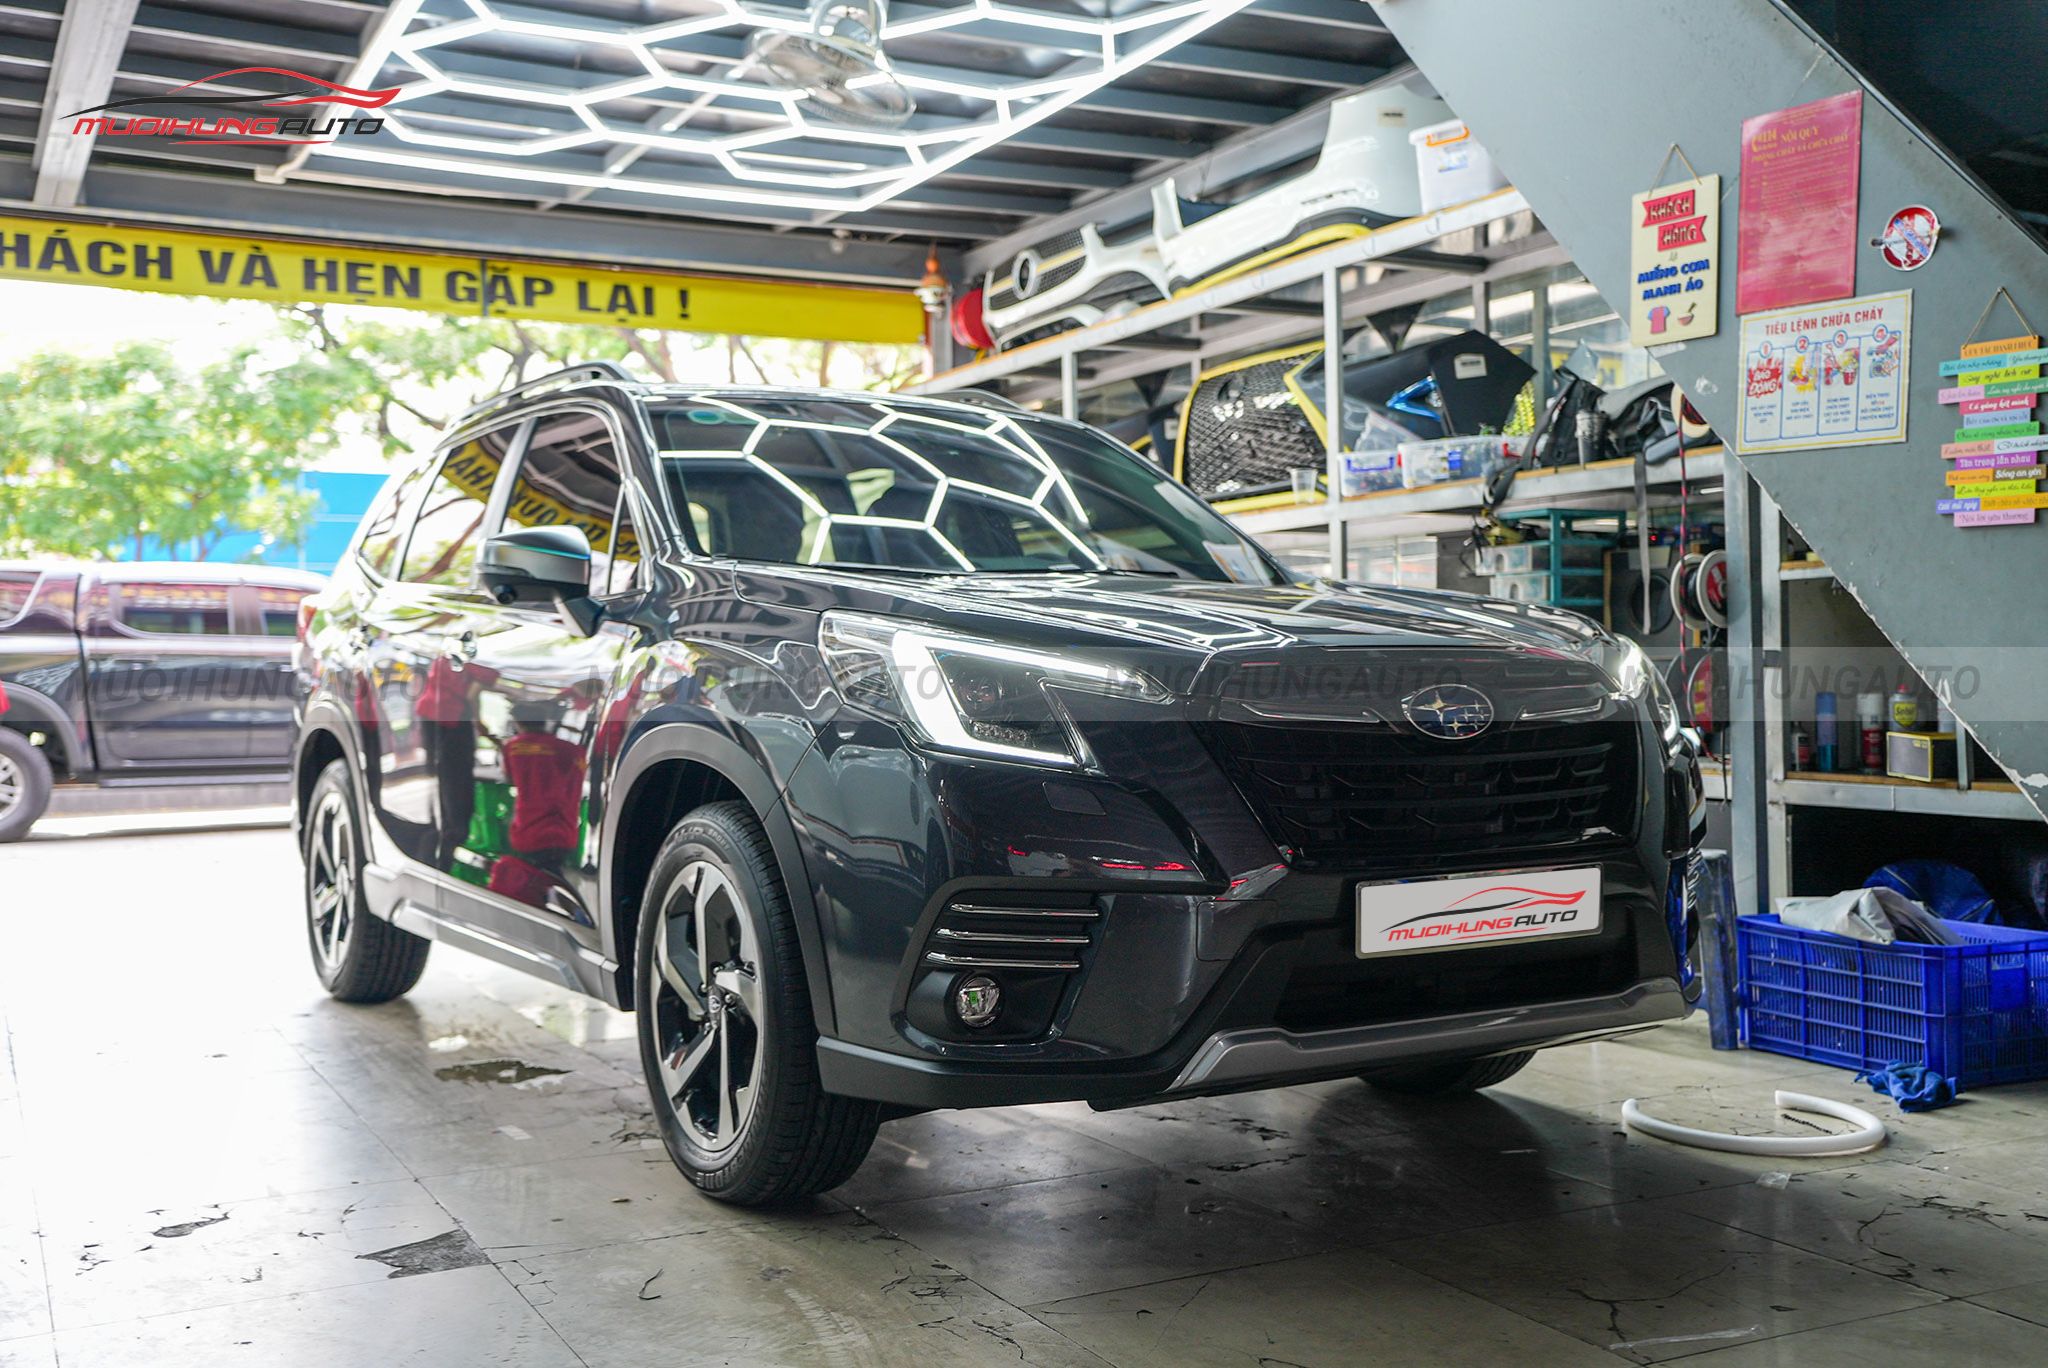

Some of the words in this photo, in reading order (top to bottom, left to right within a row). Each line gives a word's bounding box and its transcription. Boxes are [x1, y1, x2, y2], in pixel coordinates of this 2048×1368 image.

[198, 246, 279, 289] VÀ
[303, 257, 421, 303] HẸN
[446, 265, 555, 314] GẶP
[577, 281, 655, 322] LẠI
